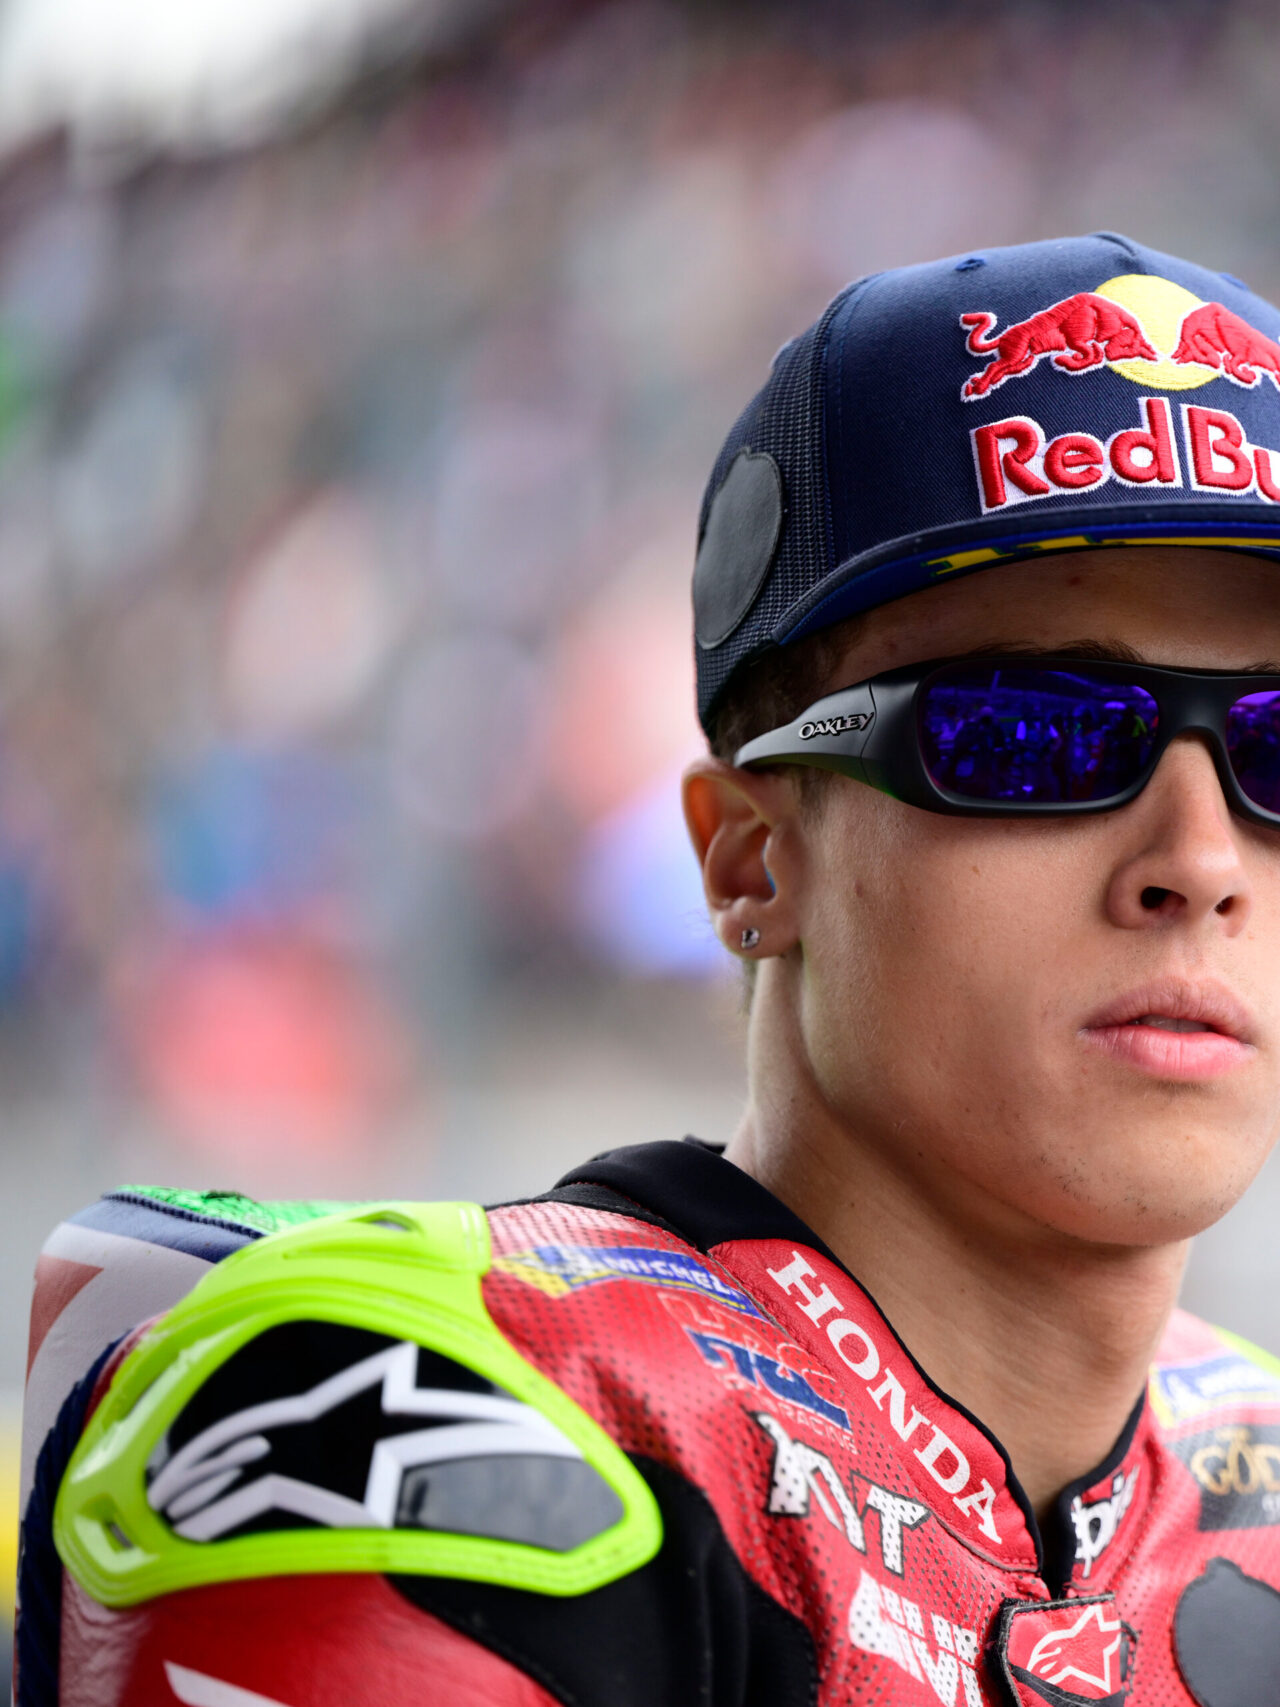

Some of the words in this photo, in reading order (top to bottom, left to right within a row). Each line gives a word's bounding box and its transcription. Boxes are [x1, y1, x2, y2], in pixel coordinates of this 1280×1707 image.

[970, 396, 1183, 515] Red
[799, 712, 874, 740] OAKLEY
[766, 1250, 1002, 1544] HONDA
